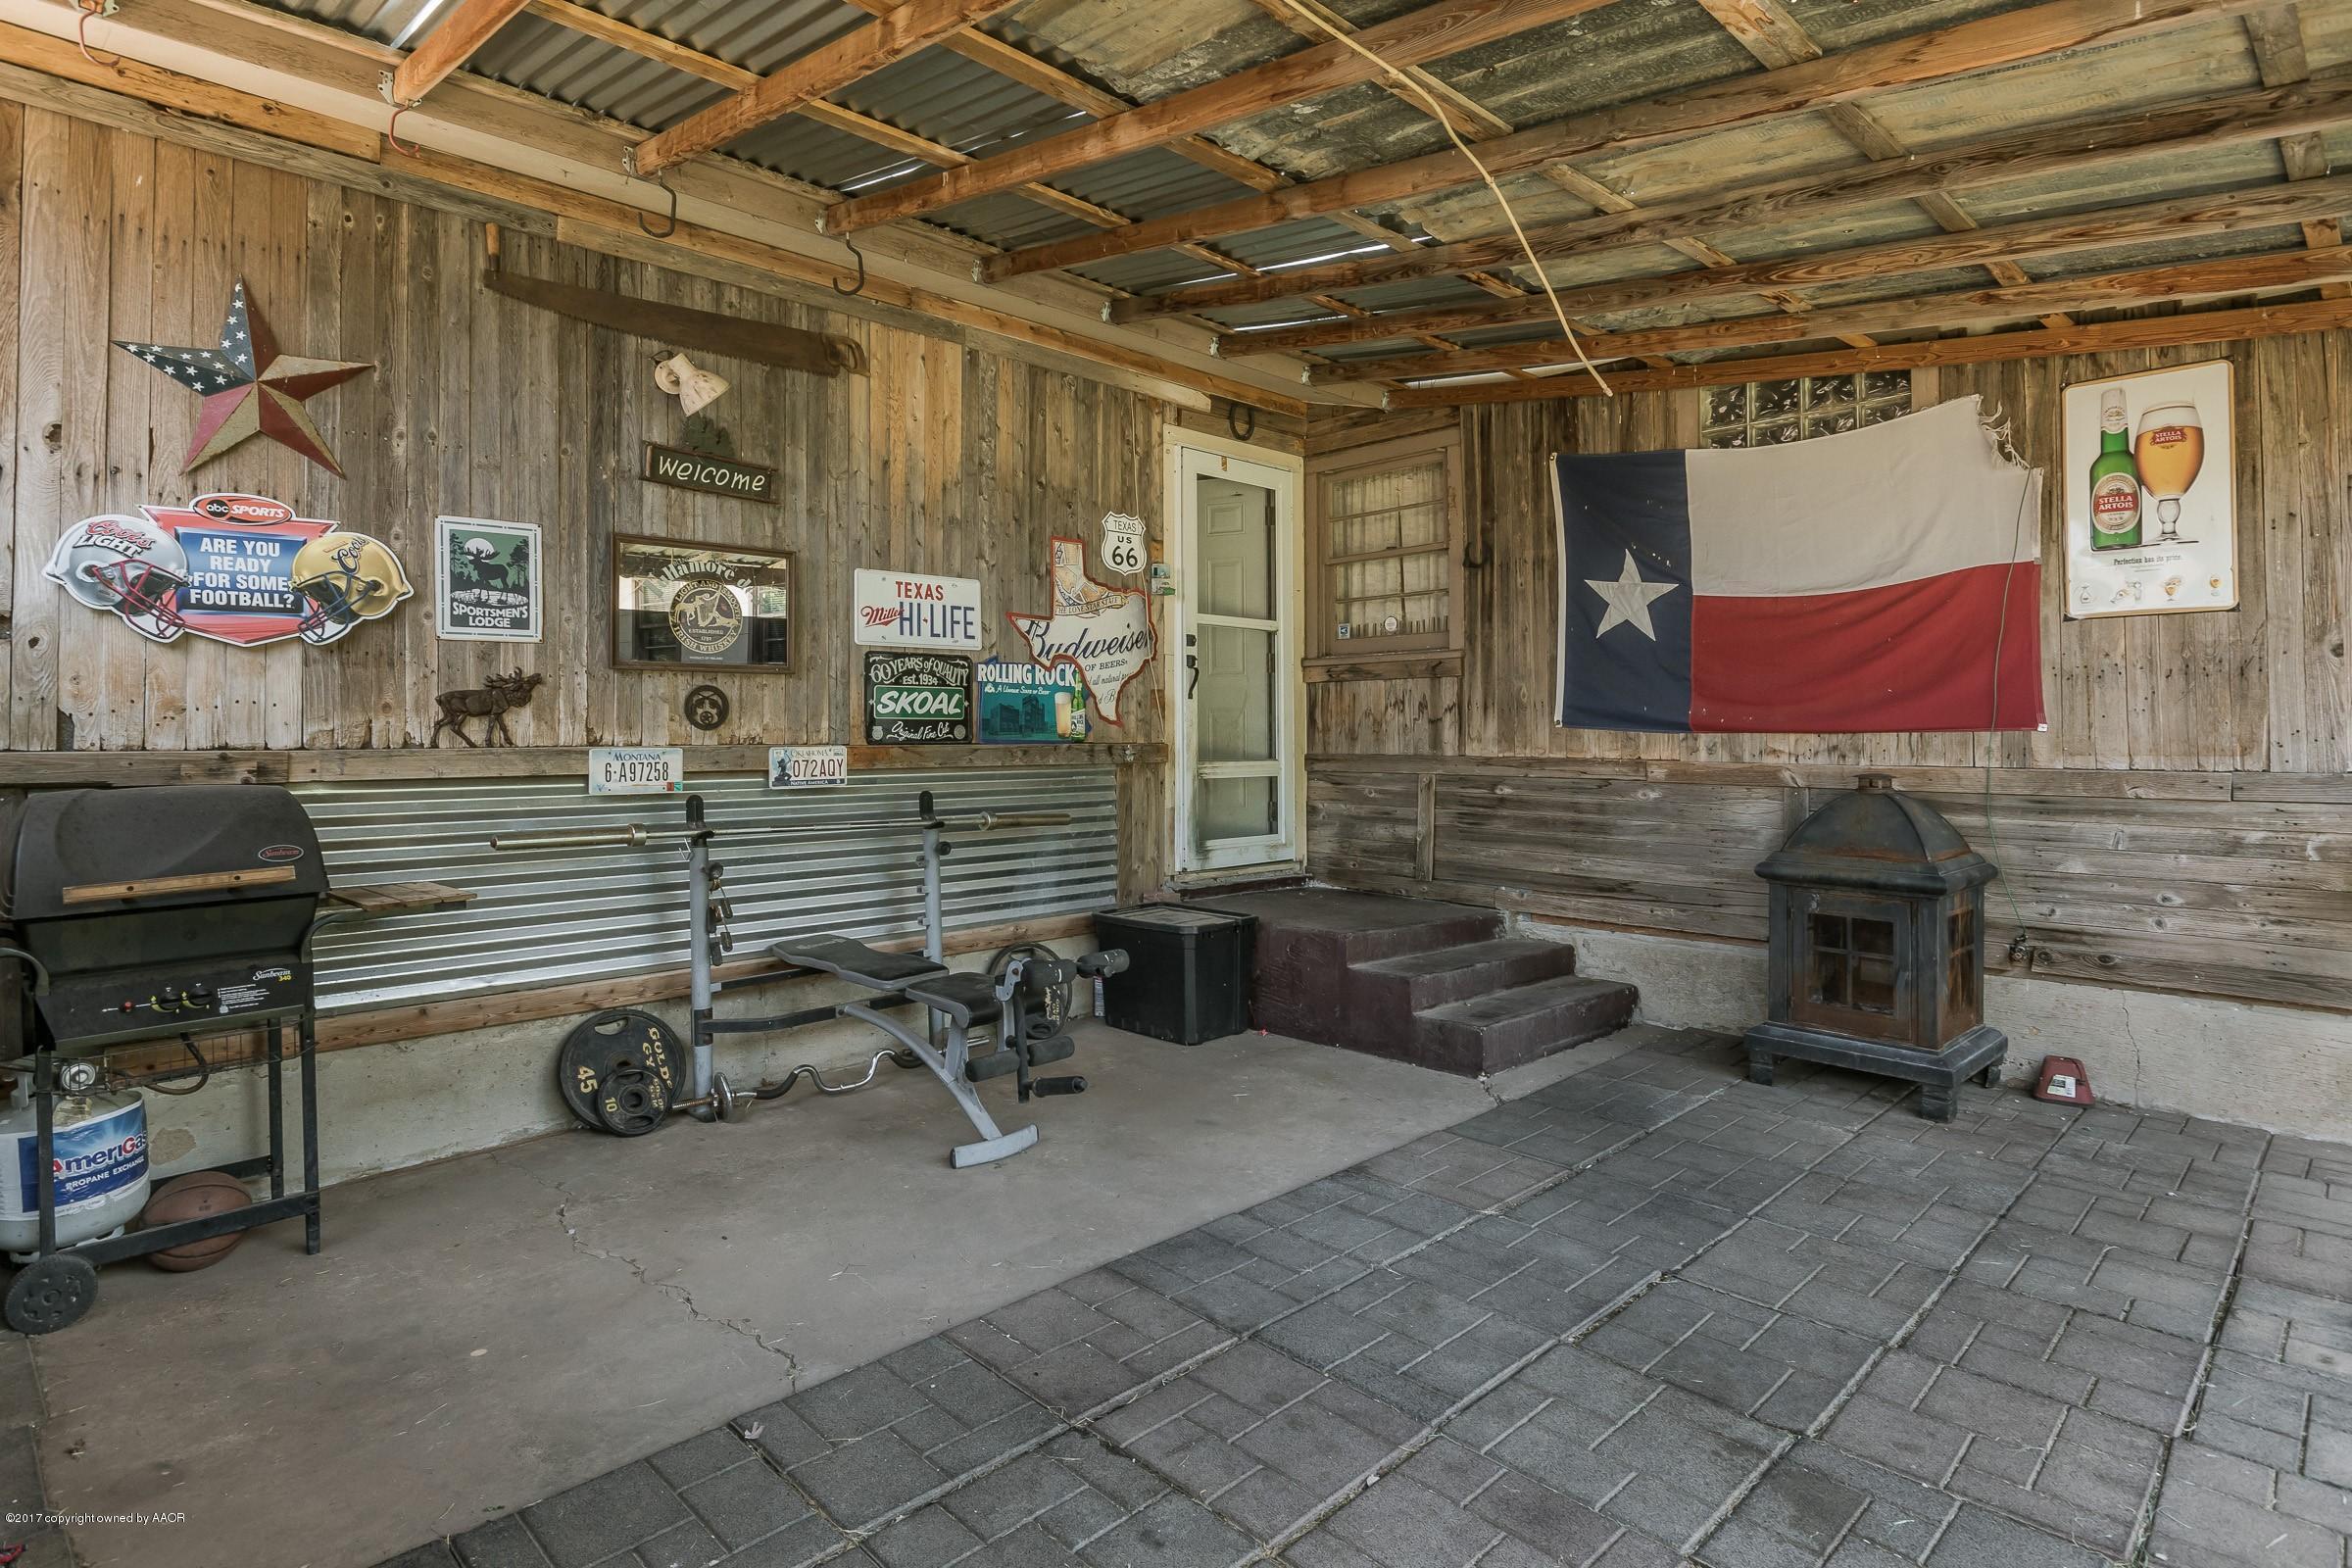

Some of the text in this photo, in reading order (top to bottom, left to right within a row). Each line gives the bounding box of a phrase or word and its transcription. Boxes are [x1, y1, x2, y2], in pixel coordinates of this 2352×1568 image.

[206, 503, 285, 517] abc SPORTS
[85, 520, 156, 549] Coors
[1112, 519, 1137, 533] TEXAS
[73, 534, 143, 559] LIGHT
[200, 537, 280, 558] ARE YOU
[1111, 546, 1139, 567] 66
[210, 555, 271, 573] READY
[193, 571, 288, 591] FOR SOME
[895, 580, 944, 601] TEXAS
[189, 588, 295, 608] FOOTBALL?
[675, 581, 700, 602] LIGHT
[720, 587, 743, 624] SMOOTH
[1085, 602, 1101, 612] STAR
[1101, 597, 1118, 606] STATE
[452, 602, 528, 617] SPORTSMEN'S
[860, 605, 905, 627] Miller
[468, 615, 511, 628] LODGE
[673, 626, 738, 652] IRISH WHISKEY
[1025, 619, 1152, 662] Budweiser
[869, 657, 969, 686] 60 YEARS of QUALITY
[978, 663, 1076, 687] ROLLING ROCK
[1084, 662, 1096, 671] OF
[919, 673, 938, 685] 1934
[876, 690, 961, 714] SKOAL
[891, 721, 950, 741] Original Fine Cut
[793, 759, 844, 778] 072AQY
[252, 968, 291, 981] Sunbeam
[577, 1065, 599, 1094] 45
[605, 1097, 618, 1112] 10
[65, 1171, 110, 1192] PROPANE
